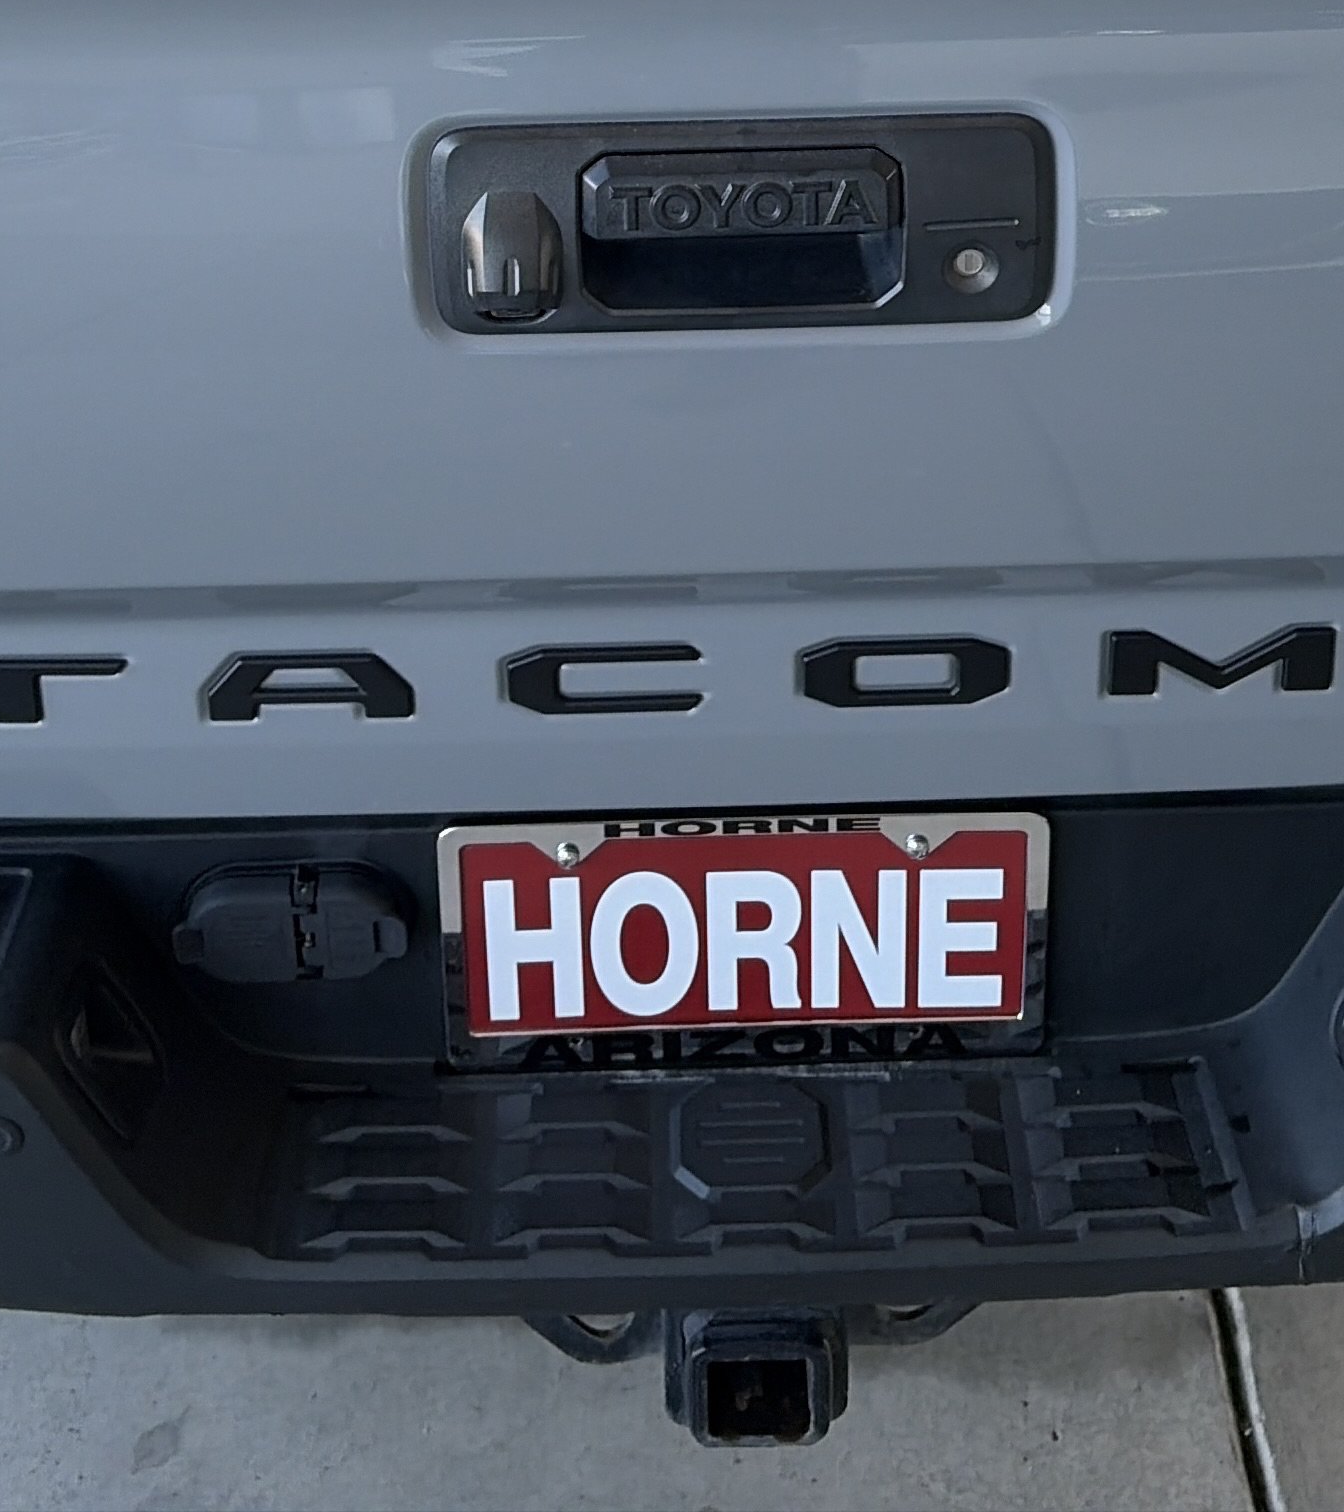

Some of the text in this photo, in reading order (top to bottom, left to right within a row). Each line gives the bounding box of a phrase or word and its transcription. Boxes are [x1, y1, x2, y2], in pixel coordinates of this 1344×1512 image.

[608, 179, 878, 232] TOYOTA
[604, 818, 881, 838] HORNE
[482, 868, 1005, 1021] HORNE
[518, 1024, 969, 1070] ARIZONA
